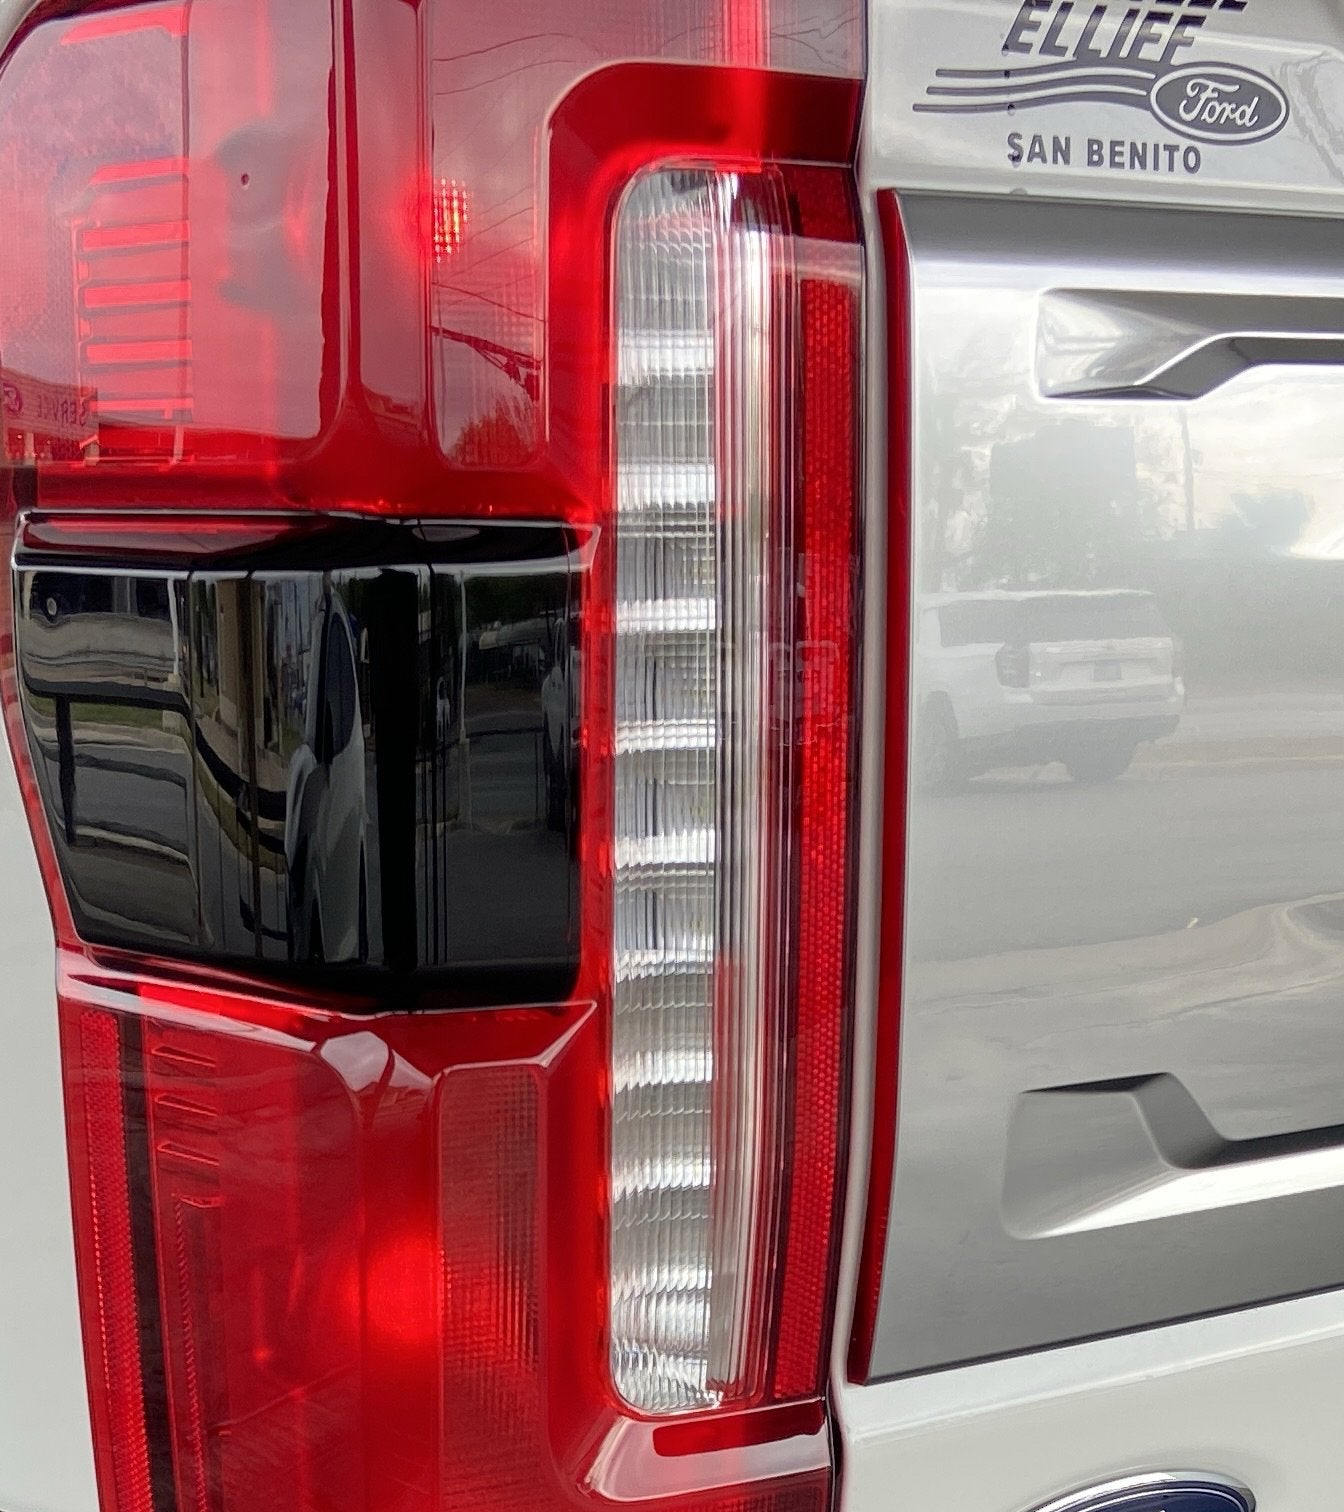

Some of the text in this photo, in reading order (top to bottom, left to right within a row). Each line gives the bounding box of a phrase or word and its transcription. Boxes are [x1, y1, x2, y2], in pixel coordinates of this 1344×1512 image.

[1002, 0, 1206, 64] ELLIFF
[1178, 78, 1259, 129] Ford
[1007, 132, 1202, 175] SAN BENITO
